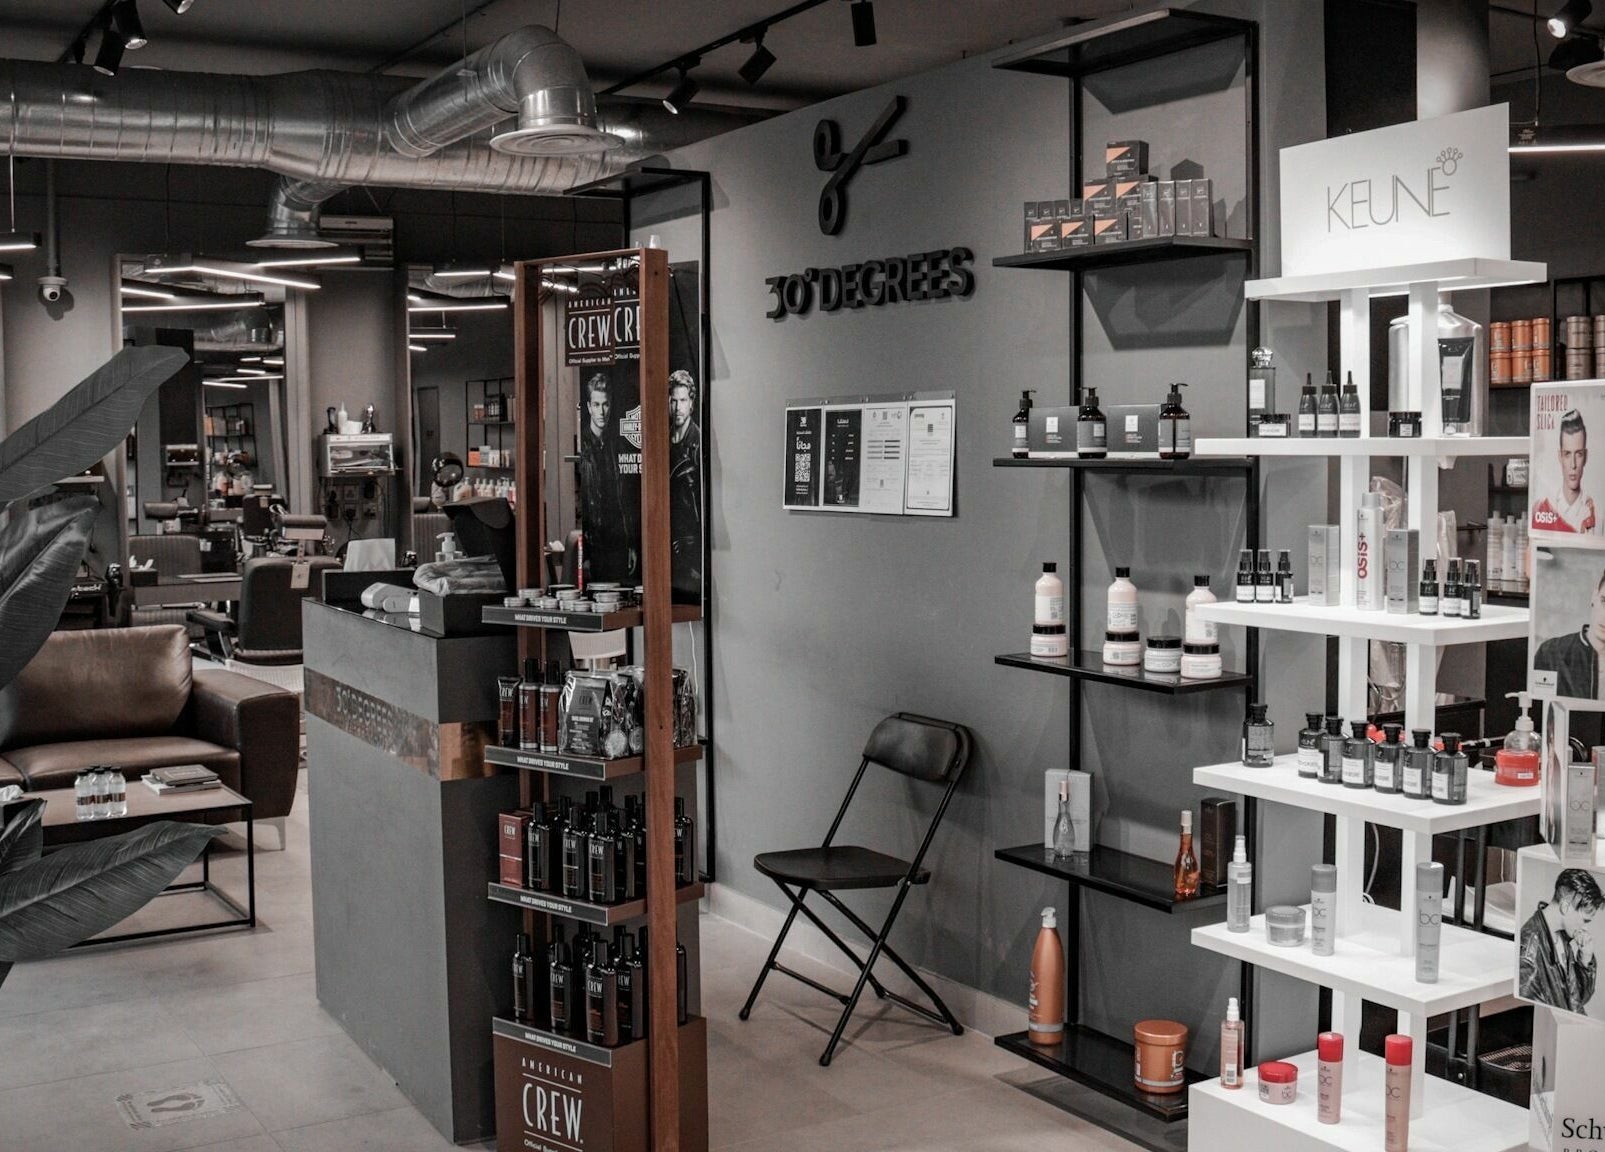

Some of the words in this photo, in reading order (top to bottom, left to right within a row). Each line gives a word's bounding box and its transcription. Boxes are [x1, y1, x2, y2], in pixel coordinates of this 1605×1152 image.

[1327, 167, 1451, 233] KEUNE
[568, 298, 611, 309] AMERICAN
[614, 305, 641, 342] CRE
[1537, 394, 1569, 413] TAILORED
[618, 453, 637, 464] WHAT
[618, 463, 638, 474] YOUR
[522, 1057, 582, 1085] AMERICAN
[1561, 1117, 1605, 1140] Sch
